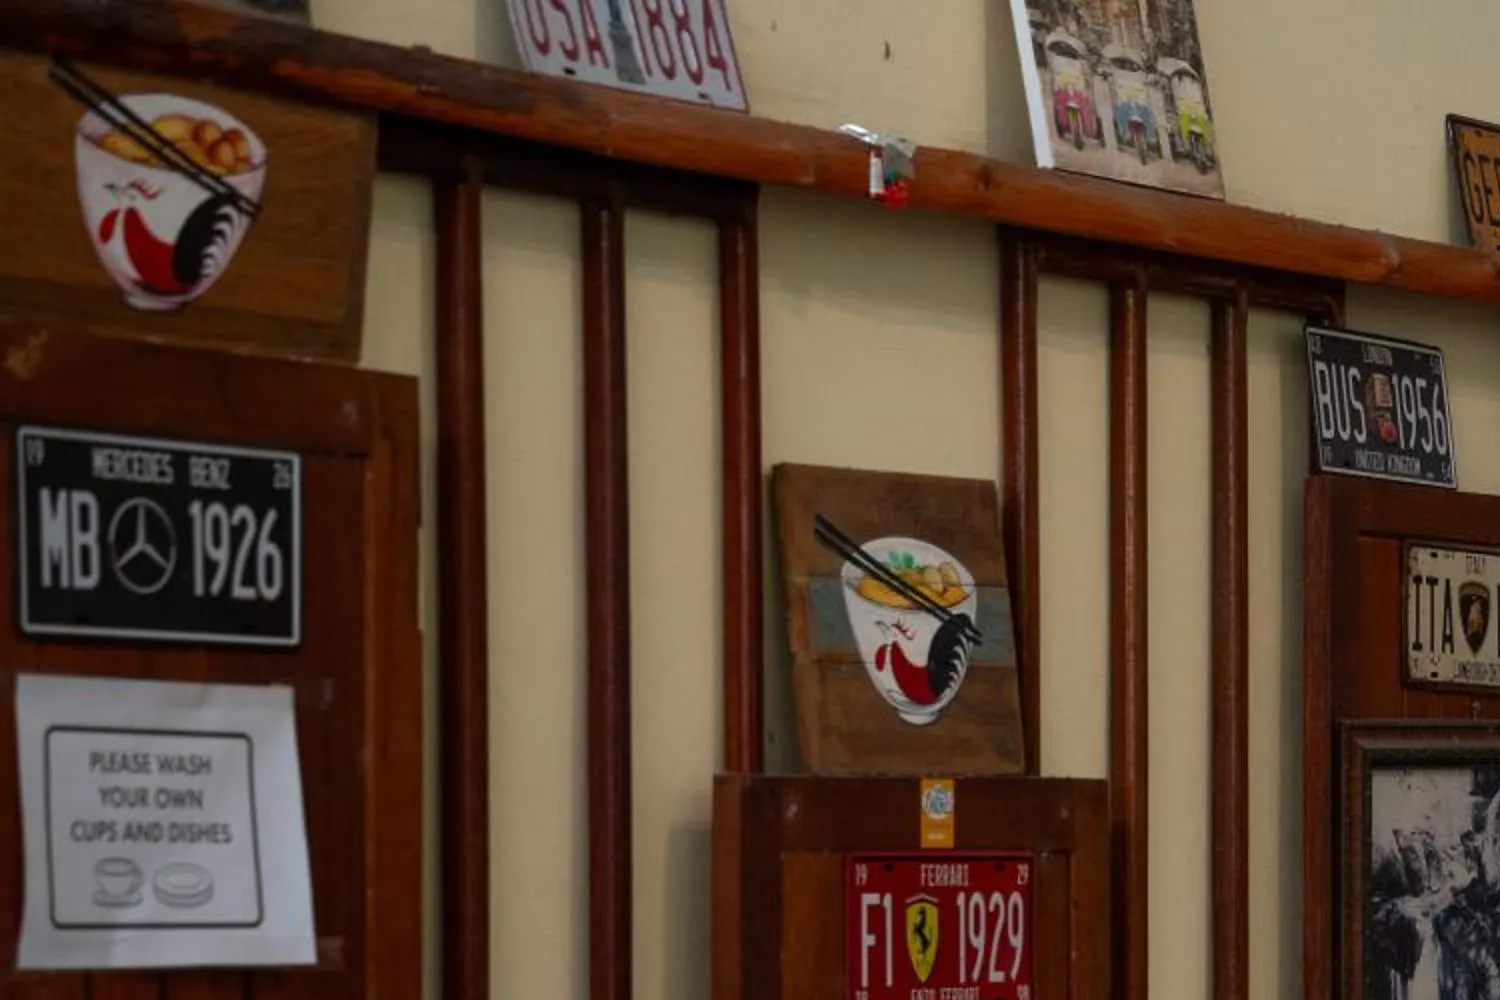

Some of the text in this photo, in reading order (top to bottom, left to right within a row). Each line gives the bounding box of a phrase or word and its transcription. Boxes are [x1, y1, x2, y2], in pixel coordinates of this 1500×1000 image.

[525, 0, 731, 91] USA 1884
[1314, 360, 1448, 455] BUS 1956
[92, 448, 174, 484] MERCEDES
[189, 456, 232, 490] BENZ
[40, 487, 284, 601] MB 1926
[1412, 574, 1455, 654] ITA
[89, 751, 212, 775] PLEASE WASH
[98, 785, 205, 809] YOUR OWN
[70, 820, 233, 845] CUPS AND DISHES
[920, 864, 969, 887] FERRARI
[861, 891, 1025, 988] F1 1929
